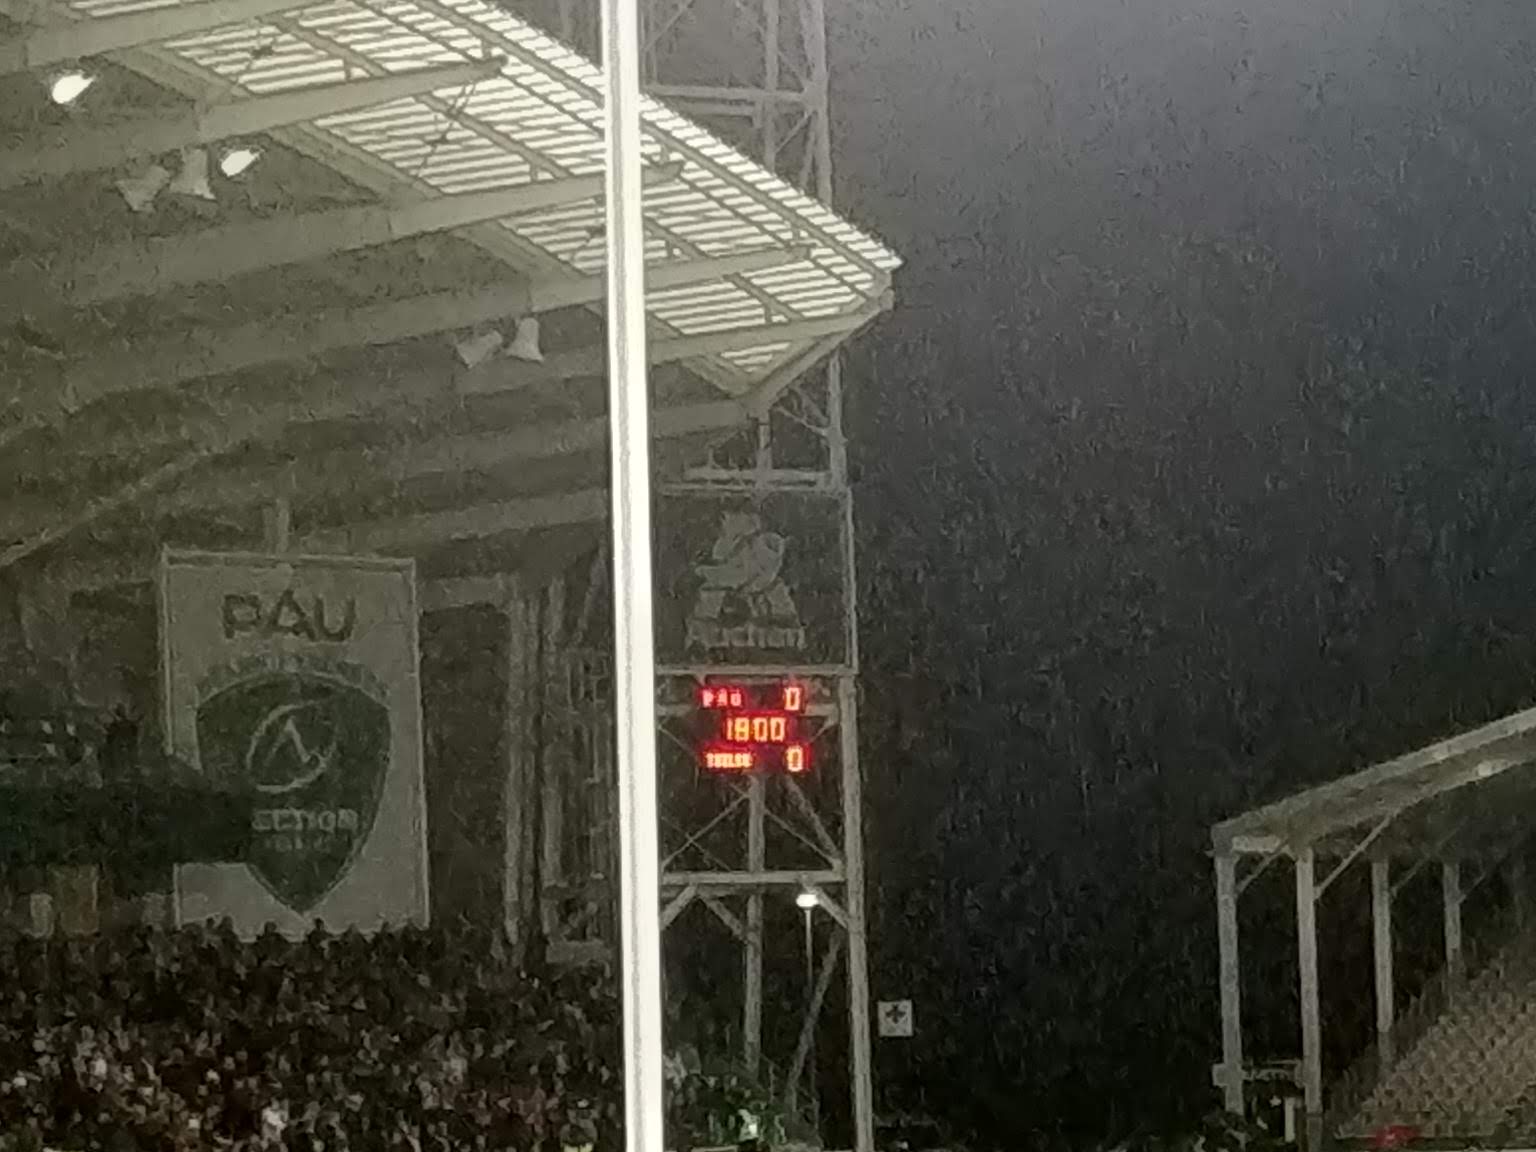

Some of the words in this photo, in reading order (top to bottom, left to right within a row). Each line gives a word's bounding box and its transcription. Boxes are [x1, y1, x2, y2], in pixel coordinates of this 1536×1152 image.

[222, 590, 356, 642] PAU
[702, 689, 742, 708] PAU
[784, 687, 800, 710] 0
[786, 745, 803, 772] 0
